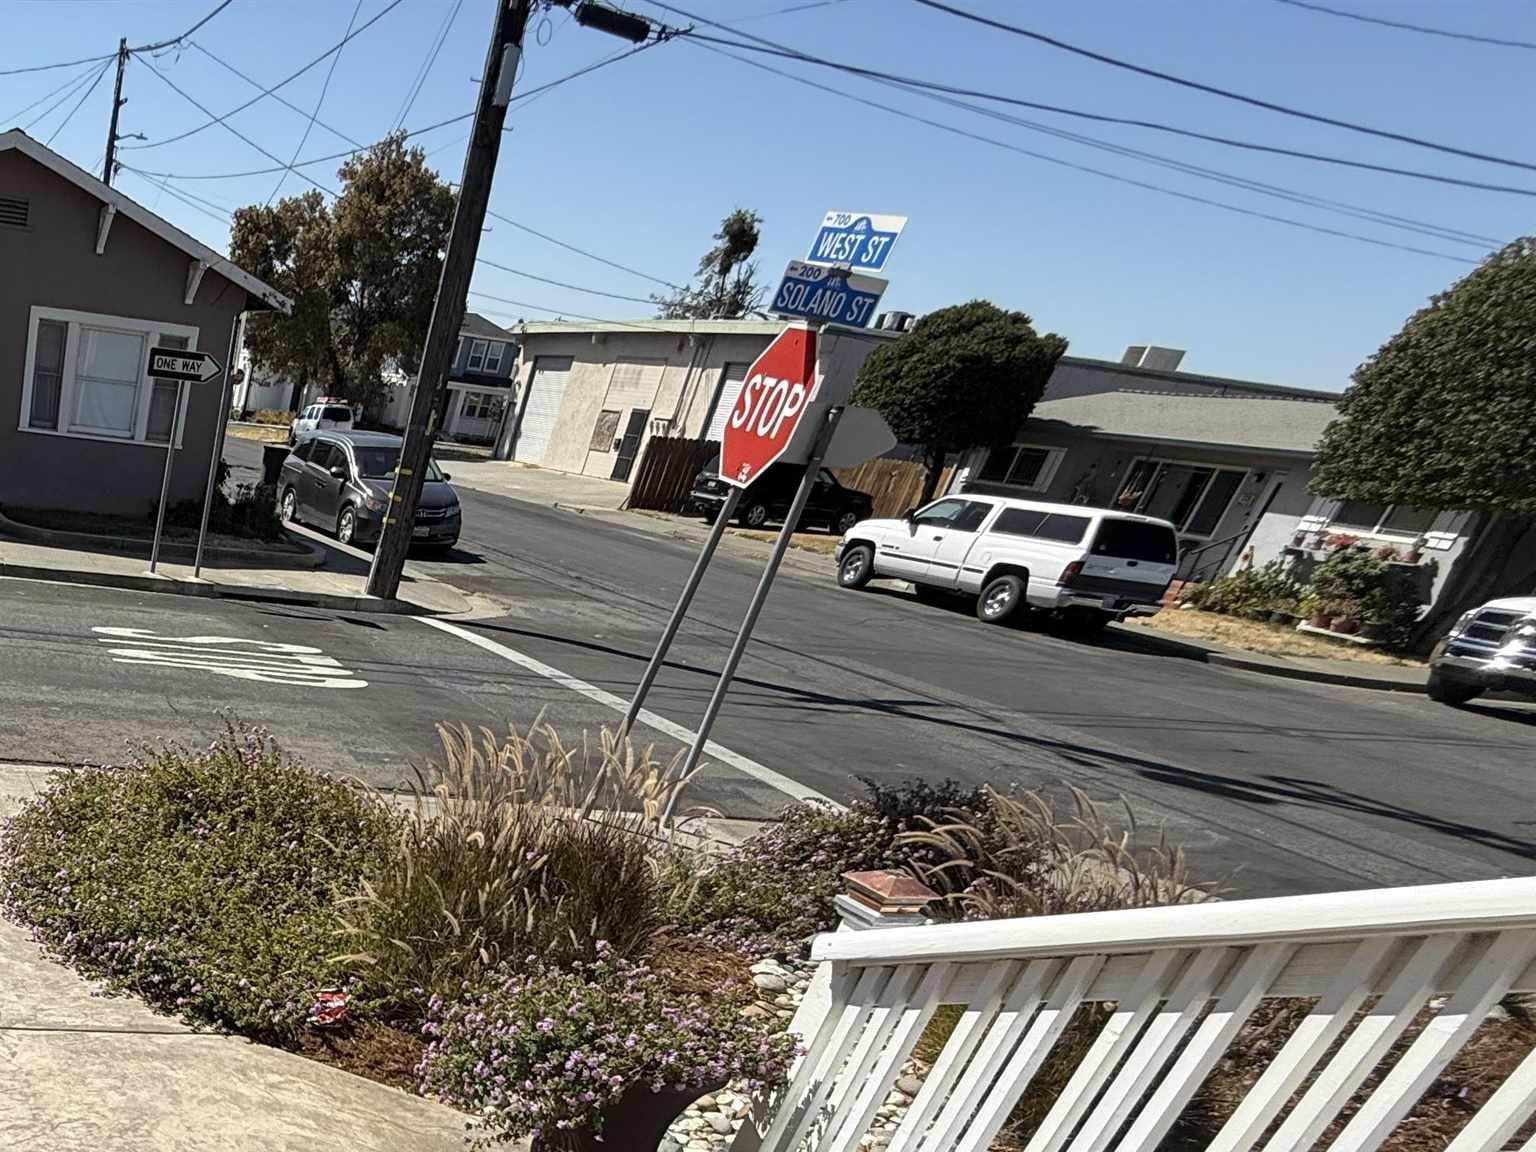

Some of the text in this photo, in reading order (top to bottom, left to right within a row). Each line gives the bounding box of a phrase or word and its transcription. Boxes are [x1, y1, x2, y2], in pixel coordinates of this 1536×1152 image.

[833, 213, 852, 226] 700
[817, 231, 890, 264] WEST ST
[799, 265, 821, 280] 200
[777, 281, 875, 323] SOLANO ST
[156, 357, 203, 373] ONE WAY
[731, 374, 806, 440] STOP
